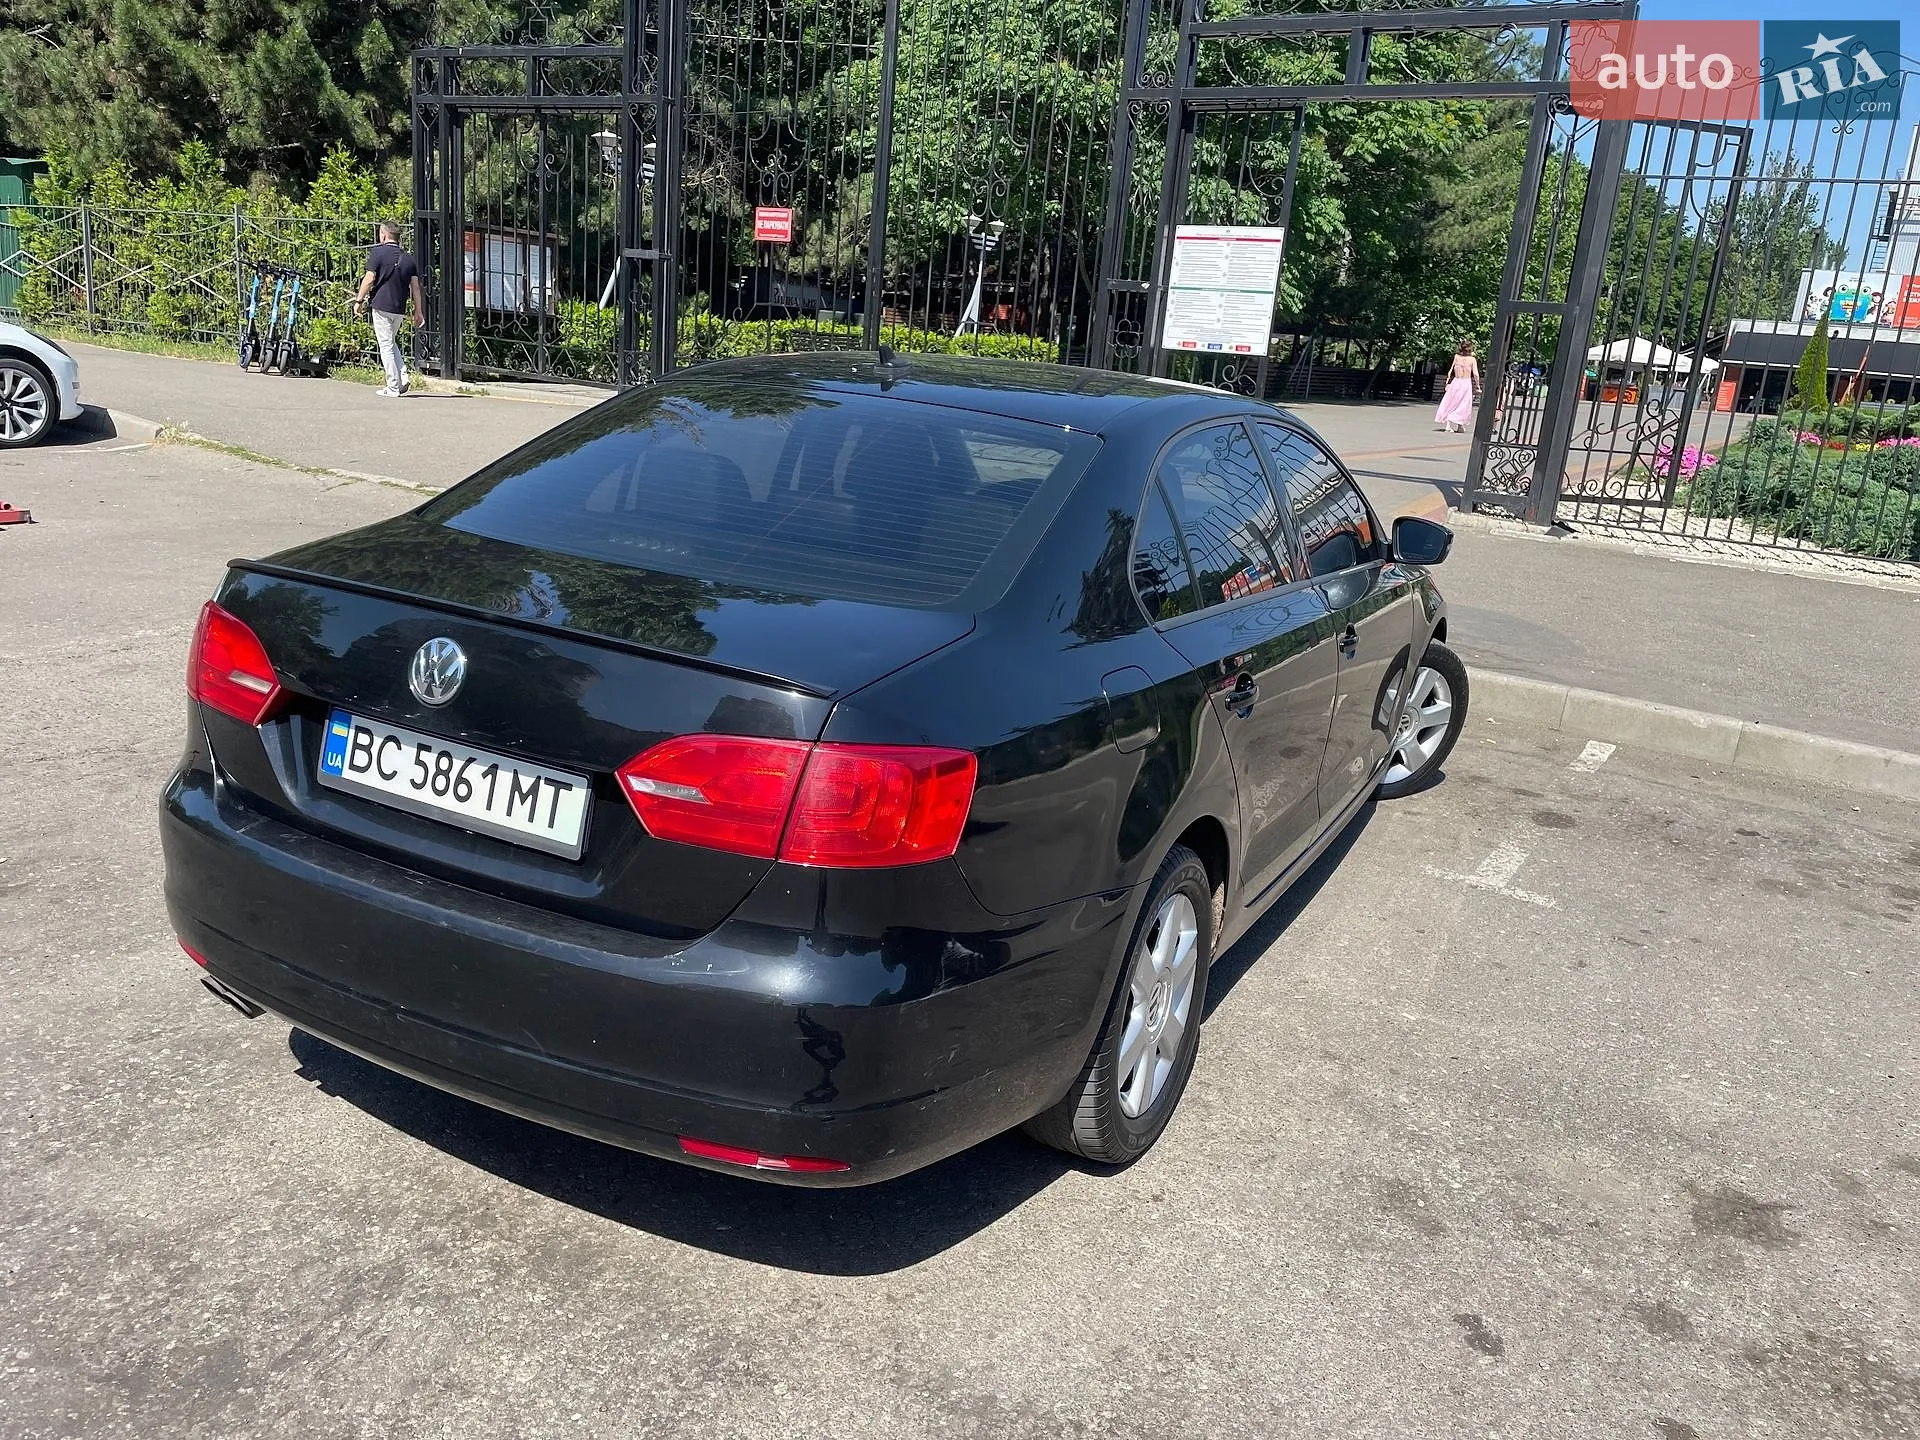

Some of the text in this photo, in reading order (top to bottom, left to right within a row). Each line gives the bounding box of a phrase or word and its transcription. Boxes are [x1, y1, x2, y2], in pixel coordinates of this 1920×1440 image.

[327, 751, 343, 769] UA
[348, 725, 573, 829] BC 5861 MT
